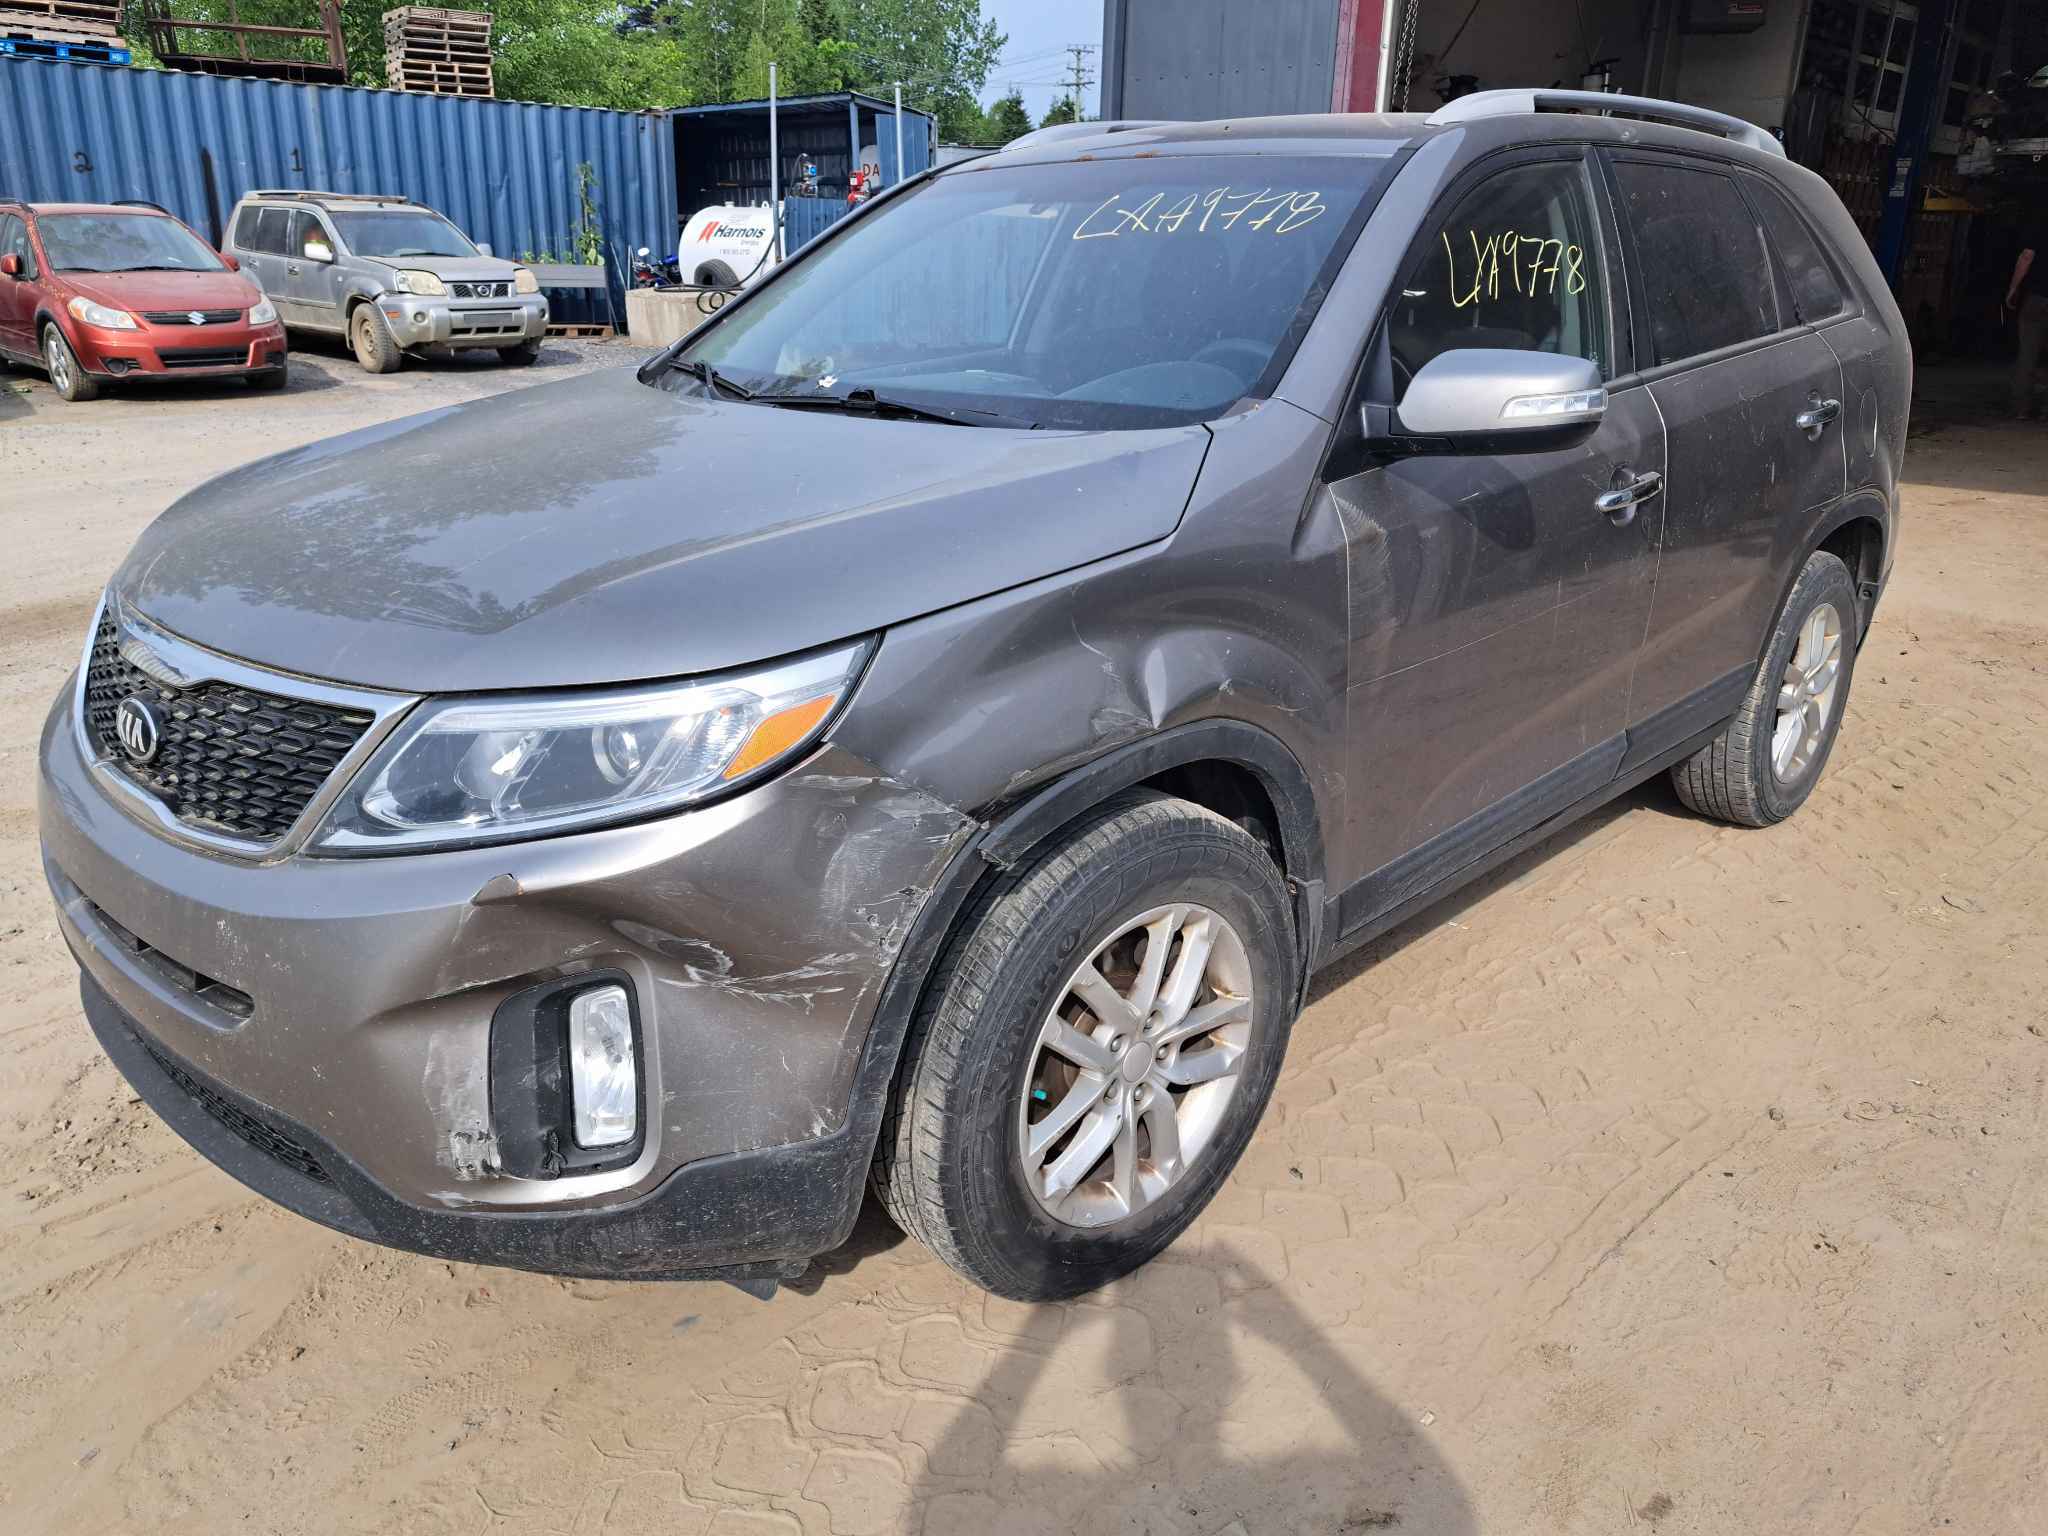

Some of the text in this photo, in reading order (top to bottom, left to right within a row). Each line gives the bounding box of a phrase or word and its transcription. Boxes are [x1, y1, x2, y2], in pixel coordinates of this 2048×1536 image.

[73, 151, 94, 174] 2
[290, 147, 304, 172] 1
[713, 224, 766, 238] Harnois
